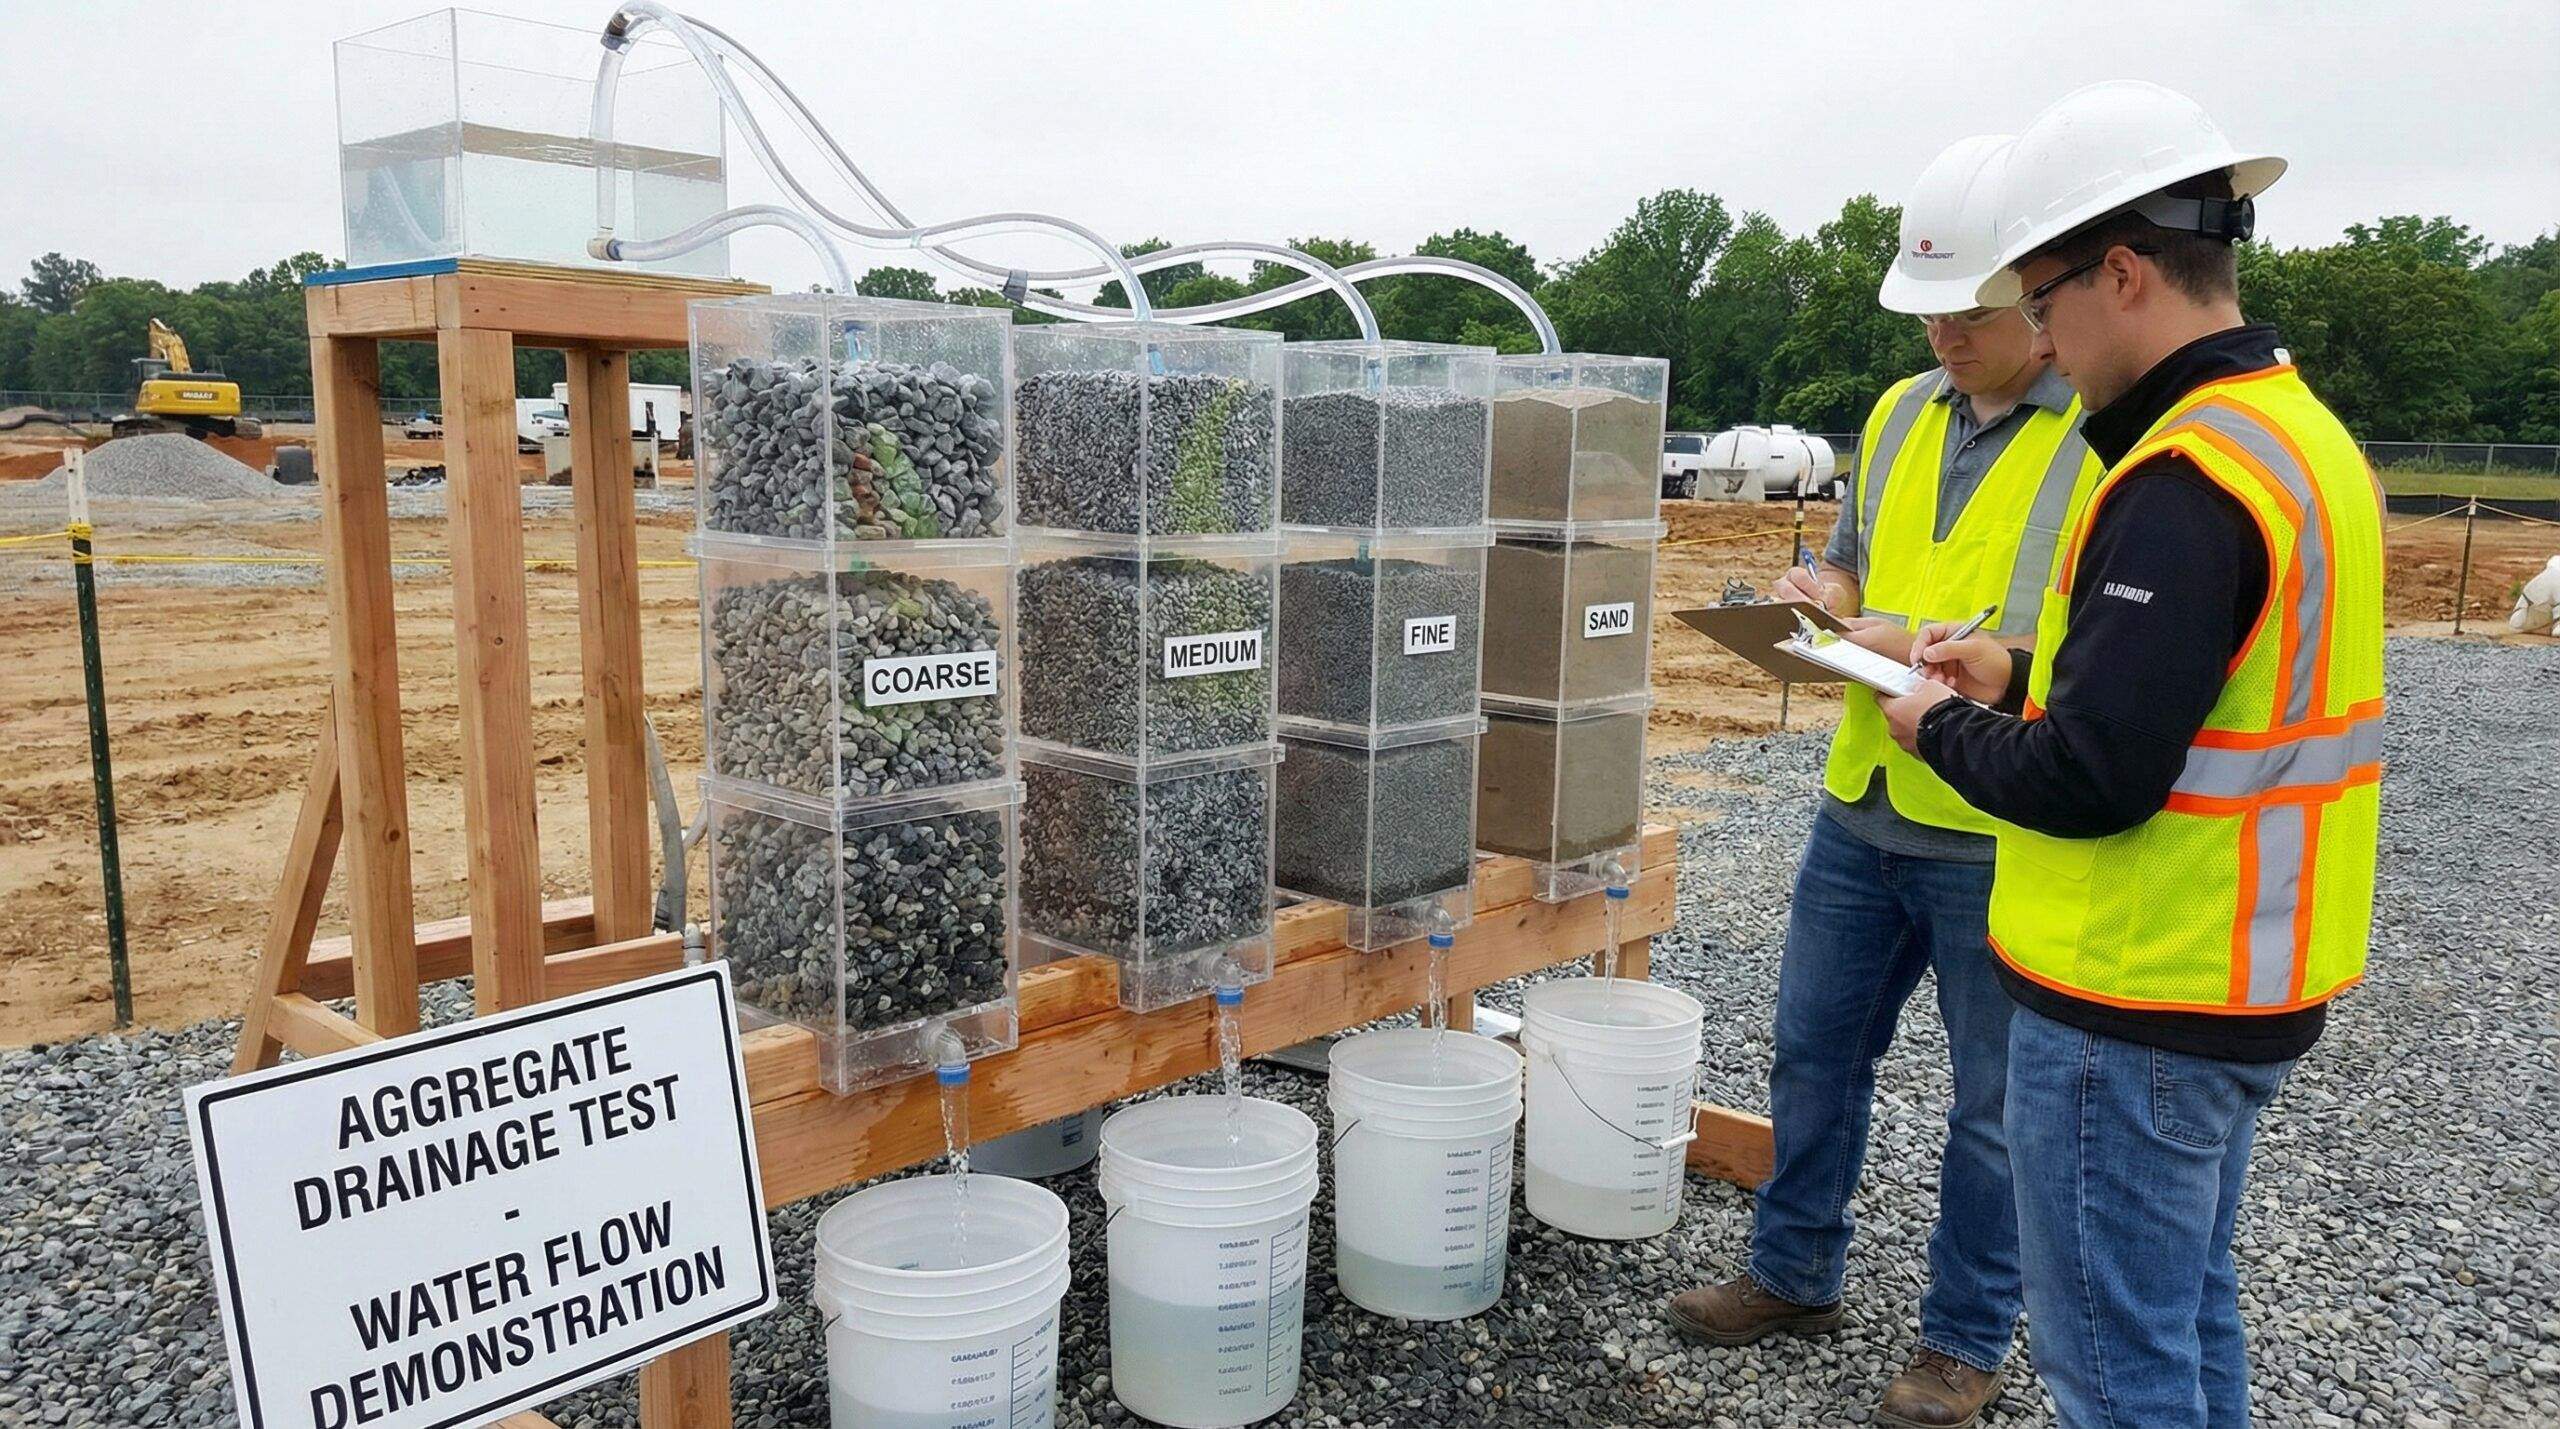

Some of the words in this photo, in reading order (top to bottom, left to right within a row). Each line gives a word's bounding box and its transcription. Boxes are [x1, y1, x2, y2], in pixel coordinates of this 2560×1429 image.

[1411, 623, 1450, 646] FINE
[1589, 609, 1629, 631] SAND
[1170, 638, 1256, 669] MEDIUM
[871, 660, 991, 695] COARSE
[338, 1026, 632, 1150] AGGREGATE
[293, 1109, 560, 1231] DRAINAGE
[569, 1074, 680, 1147] TEST
[504, 1208, 520, 1221] -
[349, 1252, 532, 1351] WATER
[543, 1200, 673, 1287] FLOW
[310, 1245, 725, 1429] DEMONSTRATION
